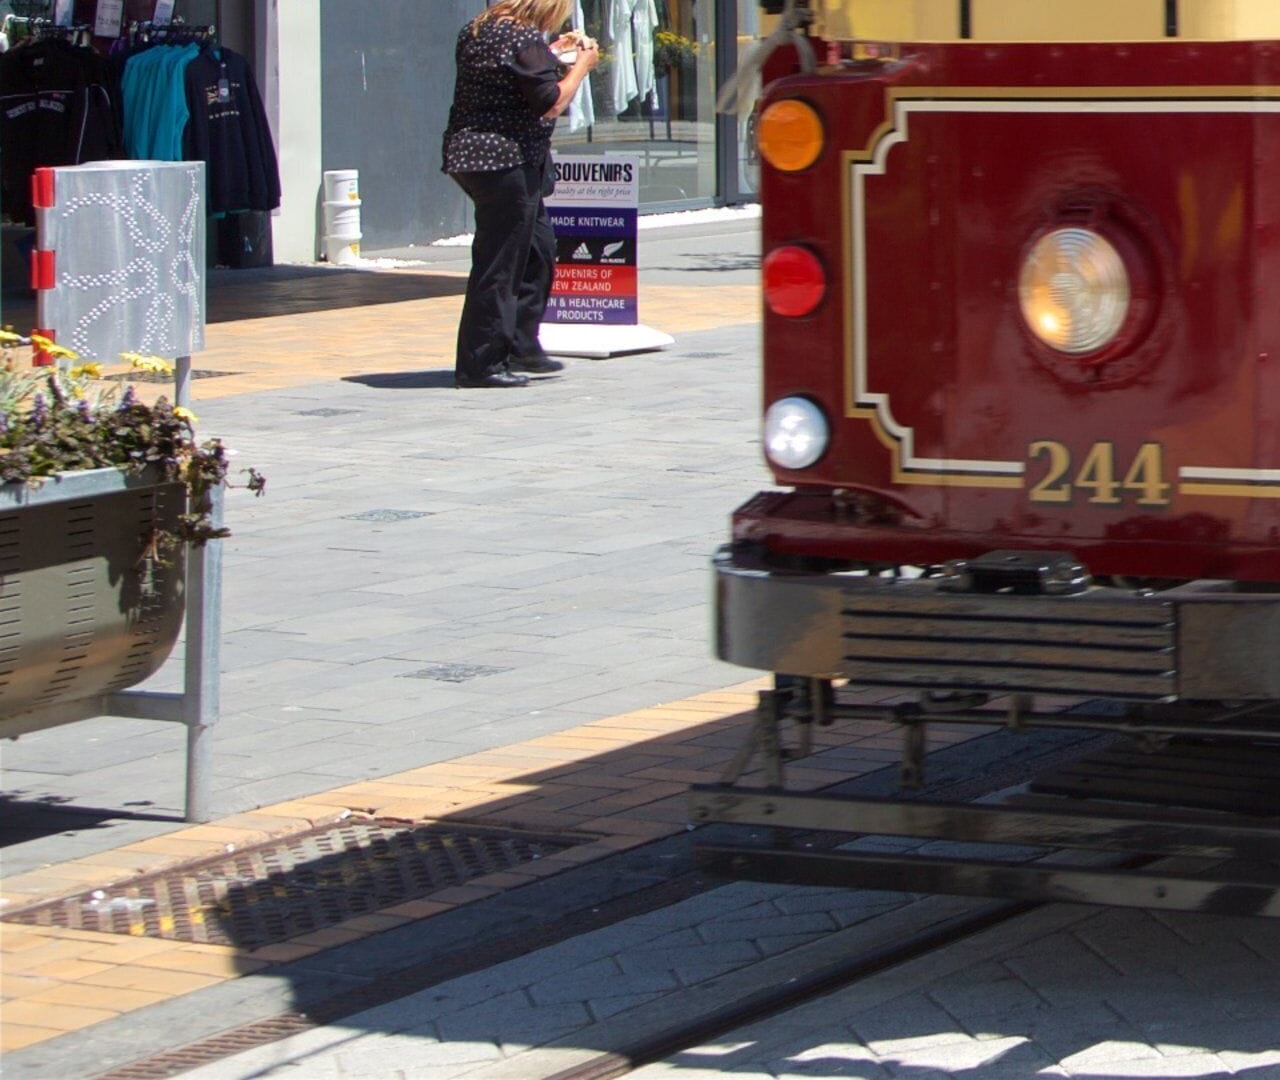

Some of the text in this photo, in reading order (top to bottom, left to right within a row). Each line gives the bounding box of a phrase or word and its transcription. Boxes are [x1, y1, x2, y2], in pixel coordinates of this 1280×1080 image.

[554, 163, 633, 182] SOUVENIRS
[587, 186, 597, 195] the
[578, 217, 625, 227] KNITWEAR
[601, 270, 612, 278] OF
[572, 281, 611, 291] ZEALAND
[560, 298, 566, 307] &
[569, 298, 625, 308] HEALTHCARE
[557, 310, 604, 320] PRODUCTS
[1028, 440, 1171, 505] 244
